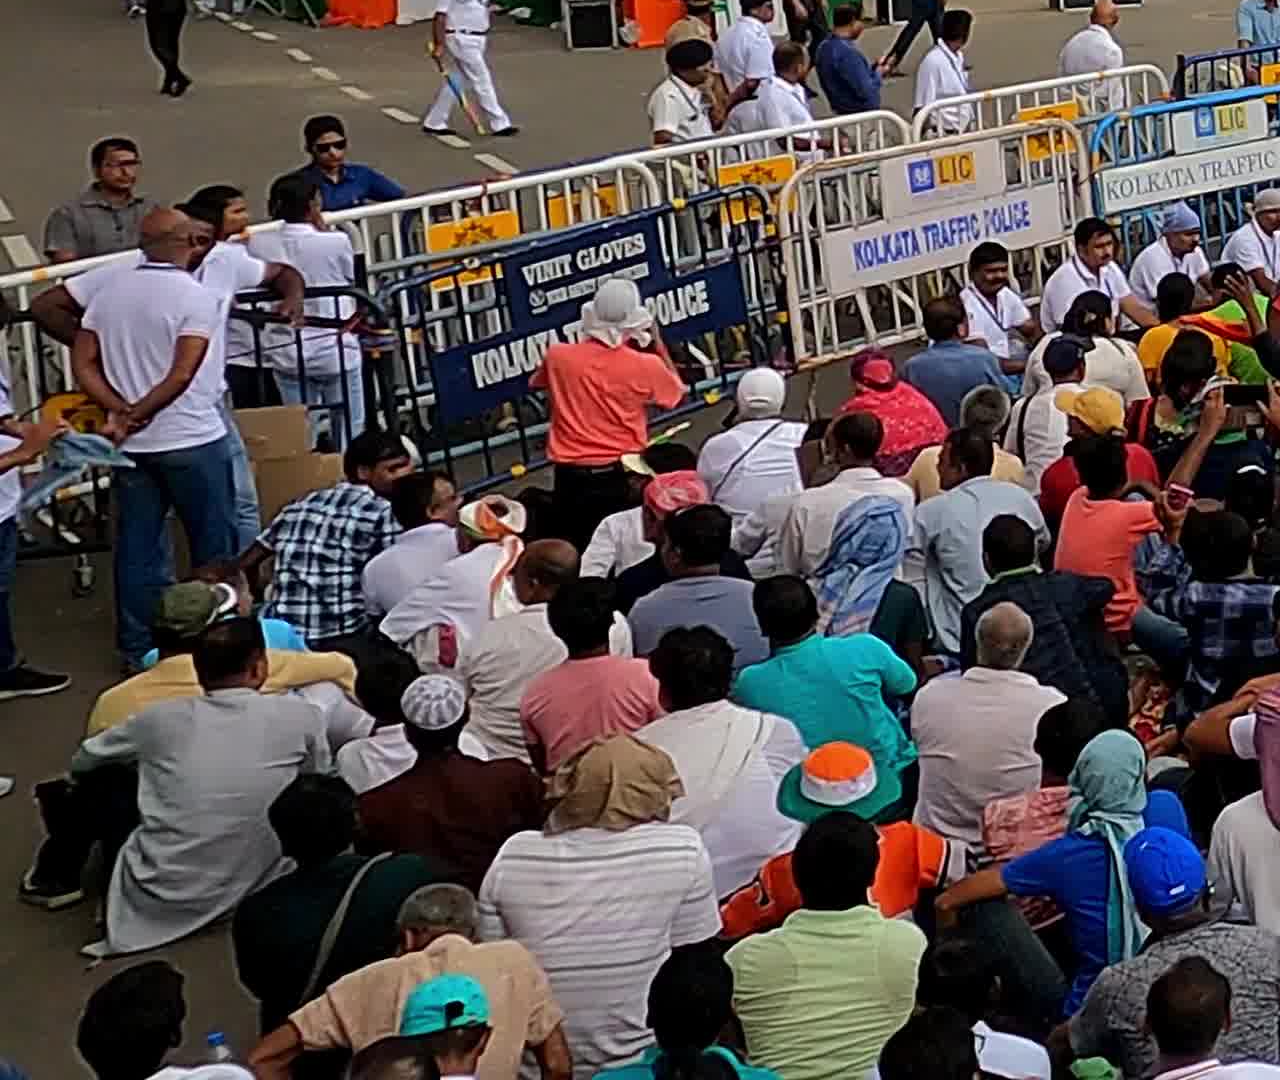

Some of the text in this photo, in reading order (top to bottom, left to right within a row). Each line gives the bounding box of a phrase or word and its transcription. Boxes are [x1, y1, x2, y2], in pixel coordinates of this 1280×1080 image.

[1218, 107, 1245, 133] LIC
[938, 154, 974, 184] LIC
[1105, 167, 1197, 201] KOLKATA
[1198, 150, 1275, 182] TRAFFIC
[576, 232, 647, 271] GLOVES
[853, 200, 1031, 271] KOLKATA TRAFFIC POLICE
[644, 280, 710, 326] POLICE
